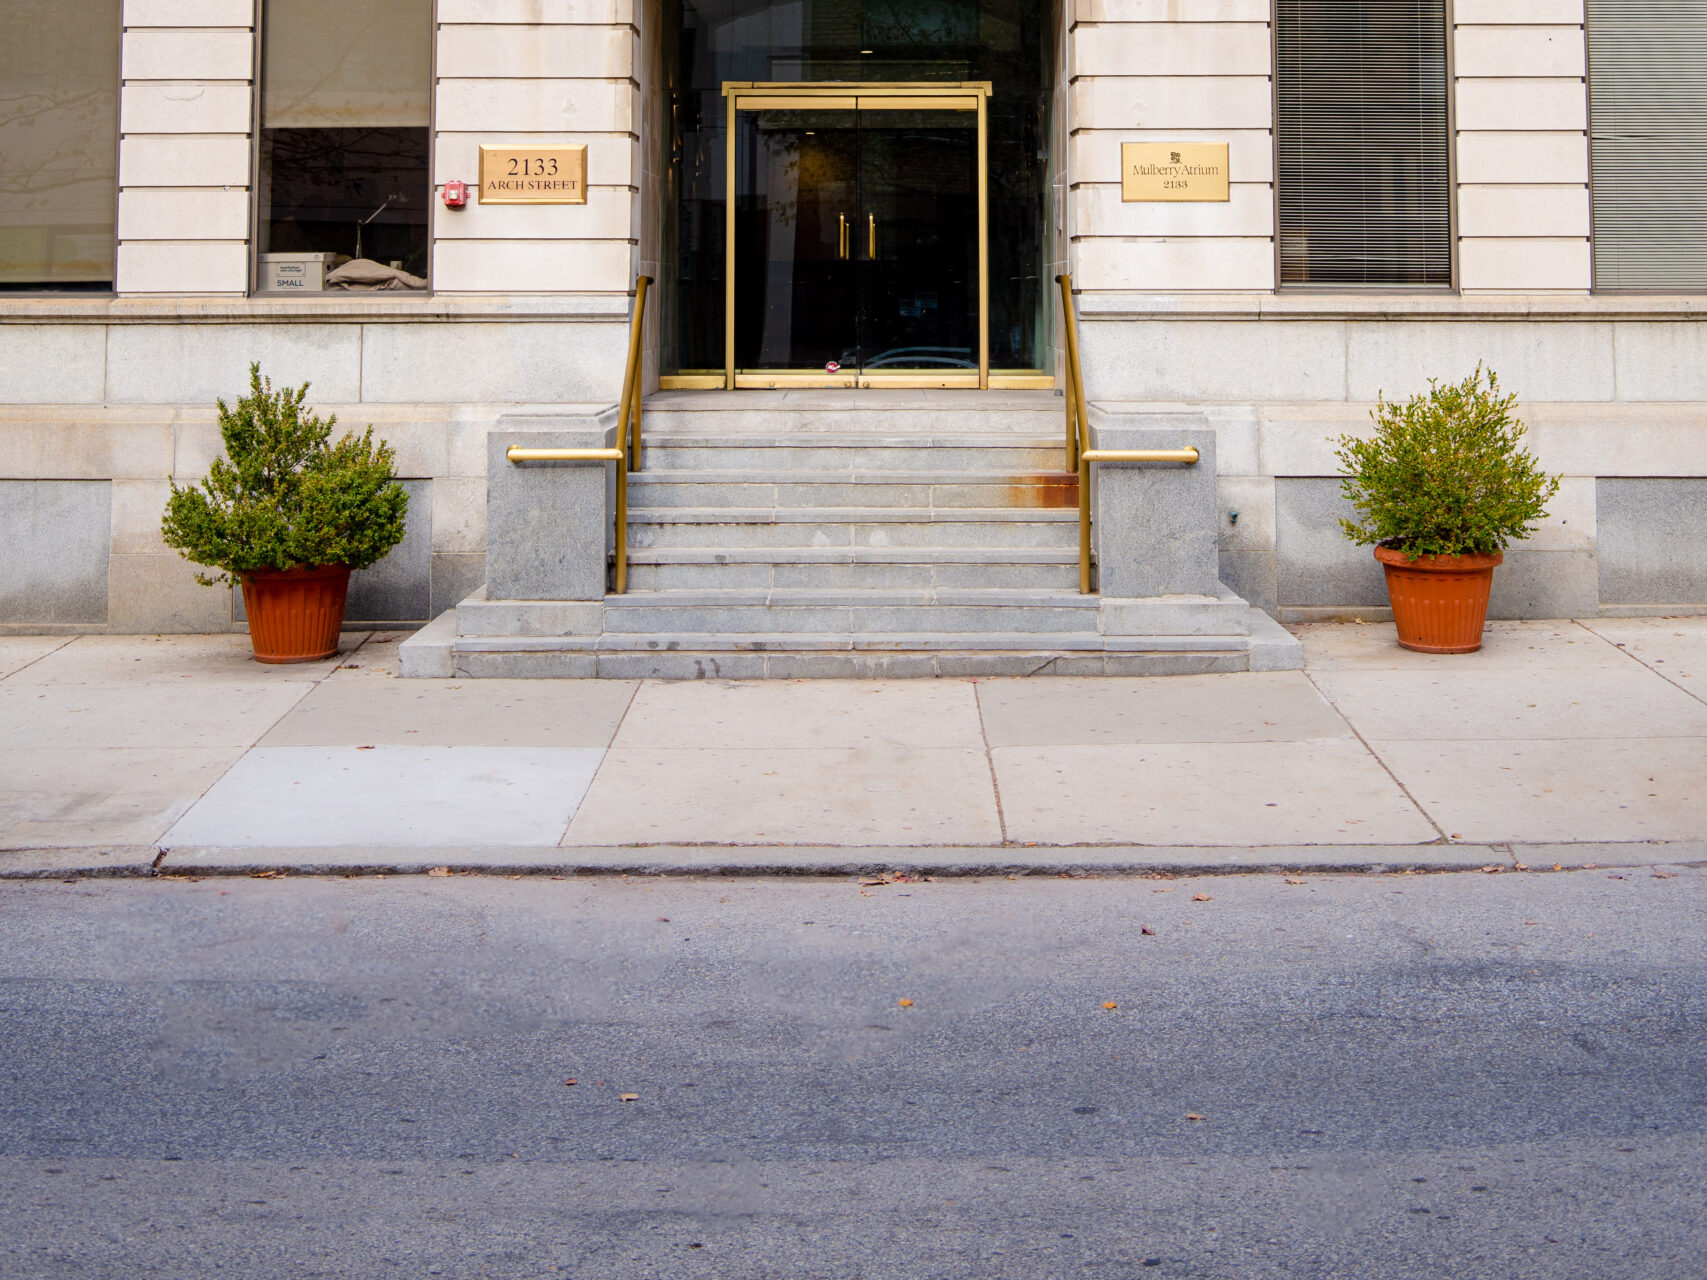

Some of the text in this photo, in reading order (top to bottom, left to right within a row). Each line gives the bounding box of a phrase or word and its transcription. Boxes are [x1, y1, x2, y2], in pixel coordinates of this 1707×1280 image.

[507, 158, 558, 176] 2133
[1132, 164, 1219, 178] Mulberry Atrium
[487, 180, 577, 190] ARCH STREET
[1163, 180, 1188, 189] 2133
[276, 279, 304, 287] SMALL
